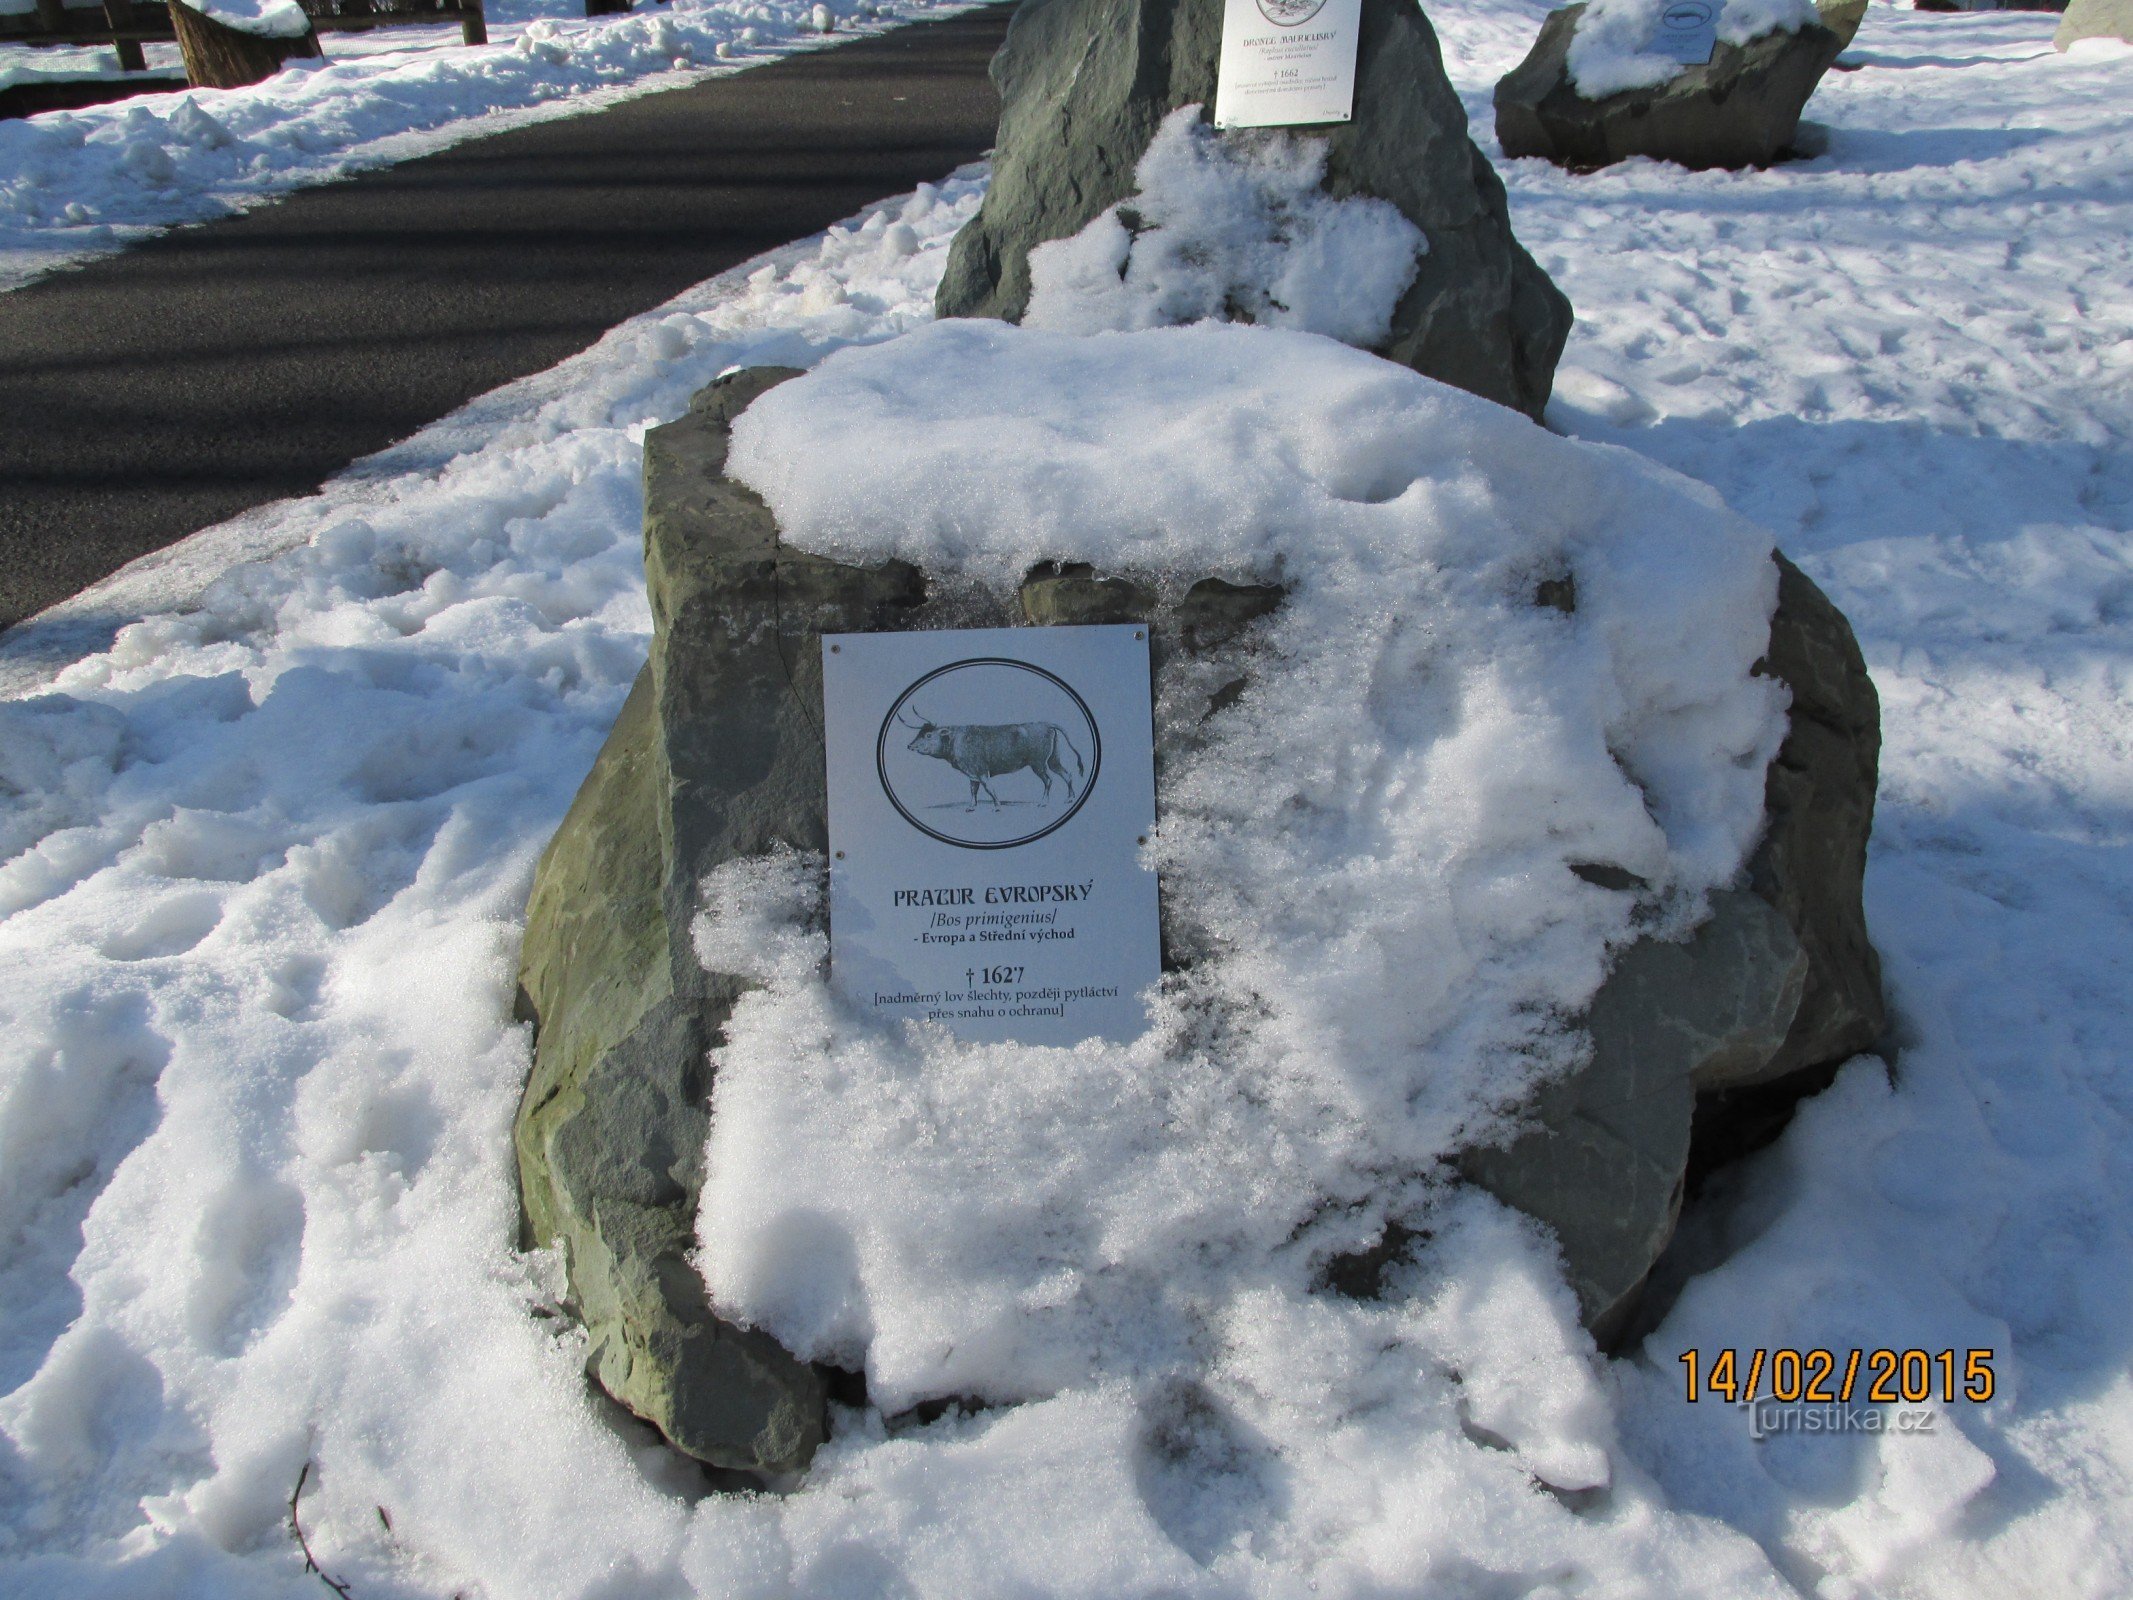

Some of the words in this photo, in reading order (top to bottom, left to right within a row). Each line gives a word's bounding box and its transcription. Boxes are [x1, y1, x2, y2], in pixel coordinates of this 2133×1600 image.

[1280, 69, 1299, 78] 1662
[893, 887, 976, 907] PRATUR
[985, 879, 1094, 904] EVROPSKÝ
[930, 912, 962, 928] /Bos
[965, 908, 1058, 930] primigenius/
[922, 932, 966, 946] Evropa
[979, 930, 1027, 942] Střední
[1029, 928, 1075, 943] východ
[981, 965, 1025, 984] 1627
[874, 992, 941, 1006] [nadměrný
[945, 990, 964, 1002] lov
[967, 988, 1012, 1004] šlechty,
[1015, 987, 1060, 1003] později
[1064, 986, 1119, 1002] pytláctví
[928, 1008, 954, 1022] přes
[957, 1006, 995, 1019] snahu
[997, 1008, 1006, 1017] o
[1009, 1003, 1064, 1018] ochranu]
